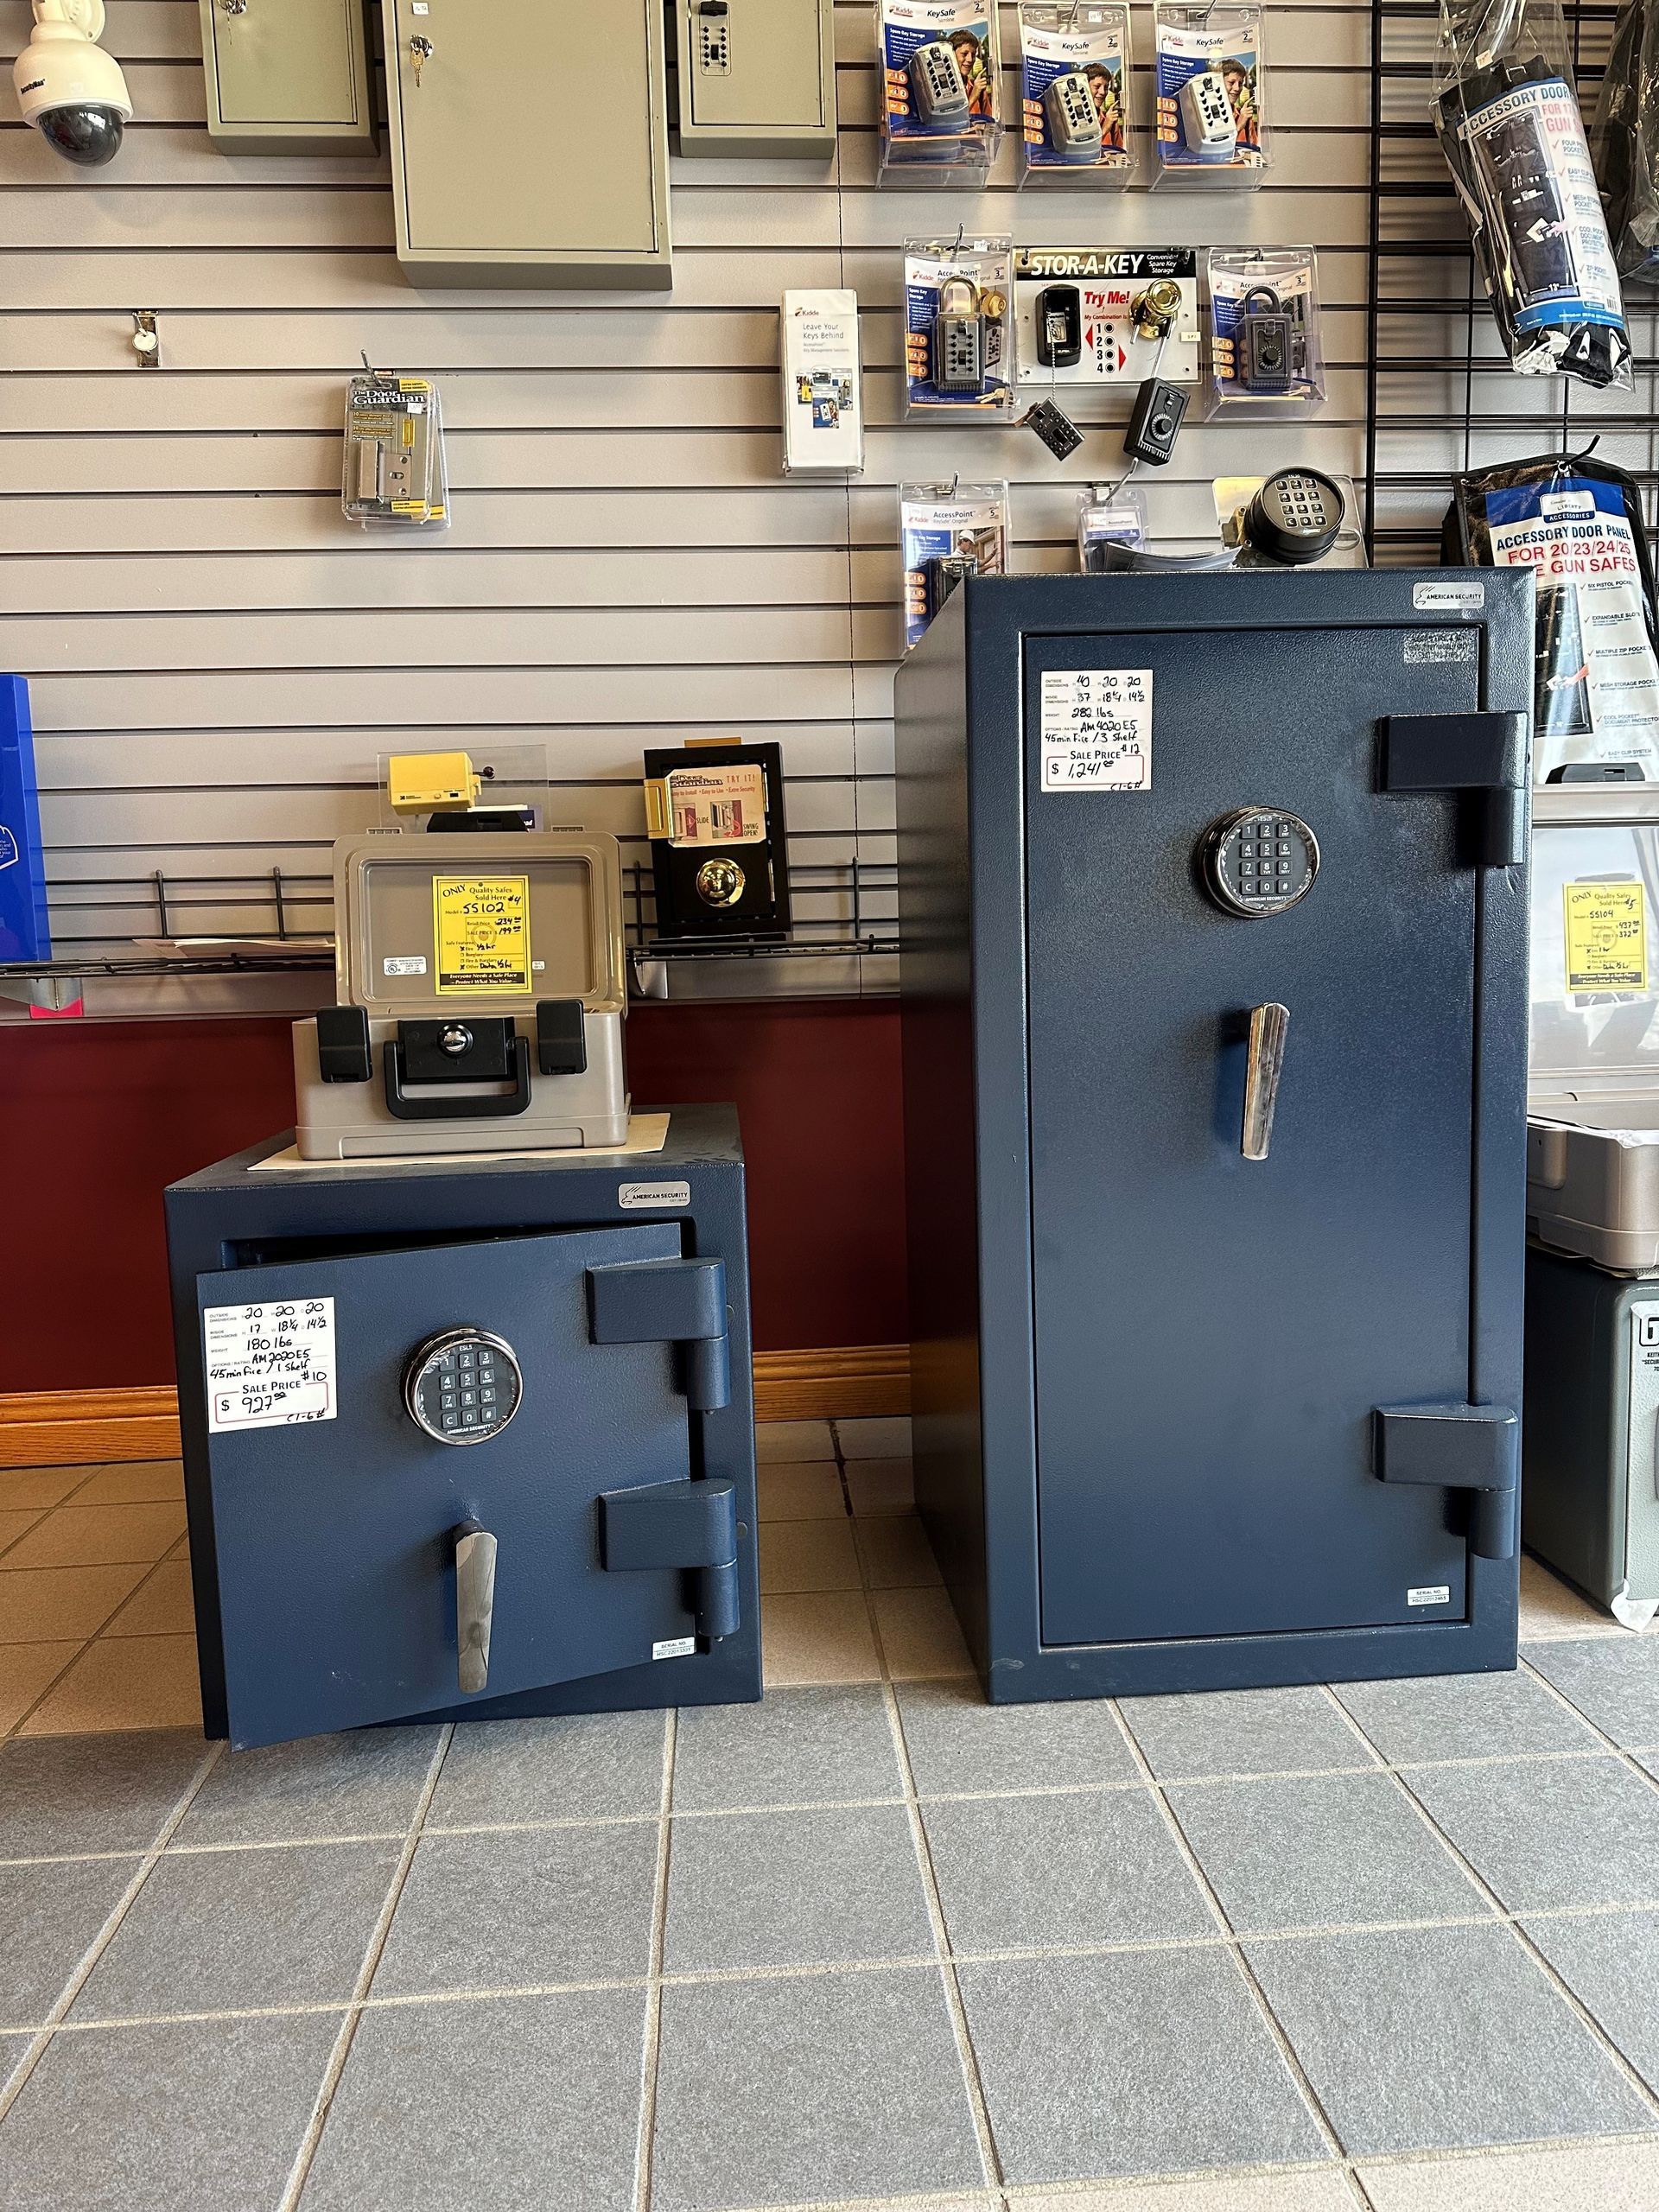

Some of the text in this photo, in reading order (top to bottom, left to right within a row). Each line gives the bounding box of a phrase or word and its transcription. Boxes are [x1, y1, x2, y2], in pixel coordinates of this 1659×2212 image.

[896, 5, 912, 14] Kidde
[927, 9, 956, 18] KeySafe
[1062, 42, 1089, 51] KeySafe
[1196, 38, 1224, 47] KeySafe
[1464, 90, 1536, 138] ACCESSORY
[1541, 103, 1560, 115] FOR
[1031, 254, 1144, 276] STOR-A-KEY
[1084, 291, 1130, 308] Try Me!
[1096, 324, 1102, 333] 1
[1096, 337, 1103, 346] 2
[1097, 350, 1103, 359] 3
[1097, 364, 1103, 372] 4
[353, 394, 425, 404] Guardian
[1549, 512, 1590, 521] ACCESSORIES
[1497, 524, 1630, 550] ACCESSORY DOOR PANEL
[1508, 541, 1630, 563] FOR 20/23/24/25
[1551, 561, 1585, 574] GUN
[1590, 556, 1636, 573] SAFES
[1127, 677, 1141, 688] 20
[1077, 693, 1090, 702] 37
[1071, 708, 1092, 717] 282
[1071, 750, 1121, 760] SALE PRICE
[442, 884, 466, 897] ONLY
[1572, 892, 1591, 903] ONLY
[245, 1307, 263, 1319] 20
[275, 1306, 295, 1317] 20
[305, 1302, 324, 1314] 20
[250, 1325, 261, 1333] 17
[247, 1338, 270, 1351] 180
[242, 1381, 302, 1395] SALE PRICE
[221, 1400, 230, 1411] $
